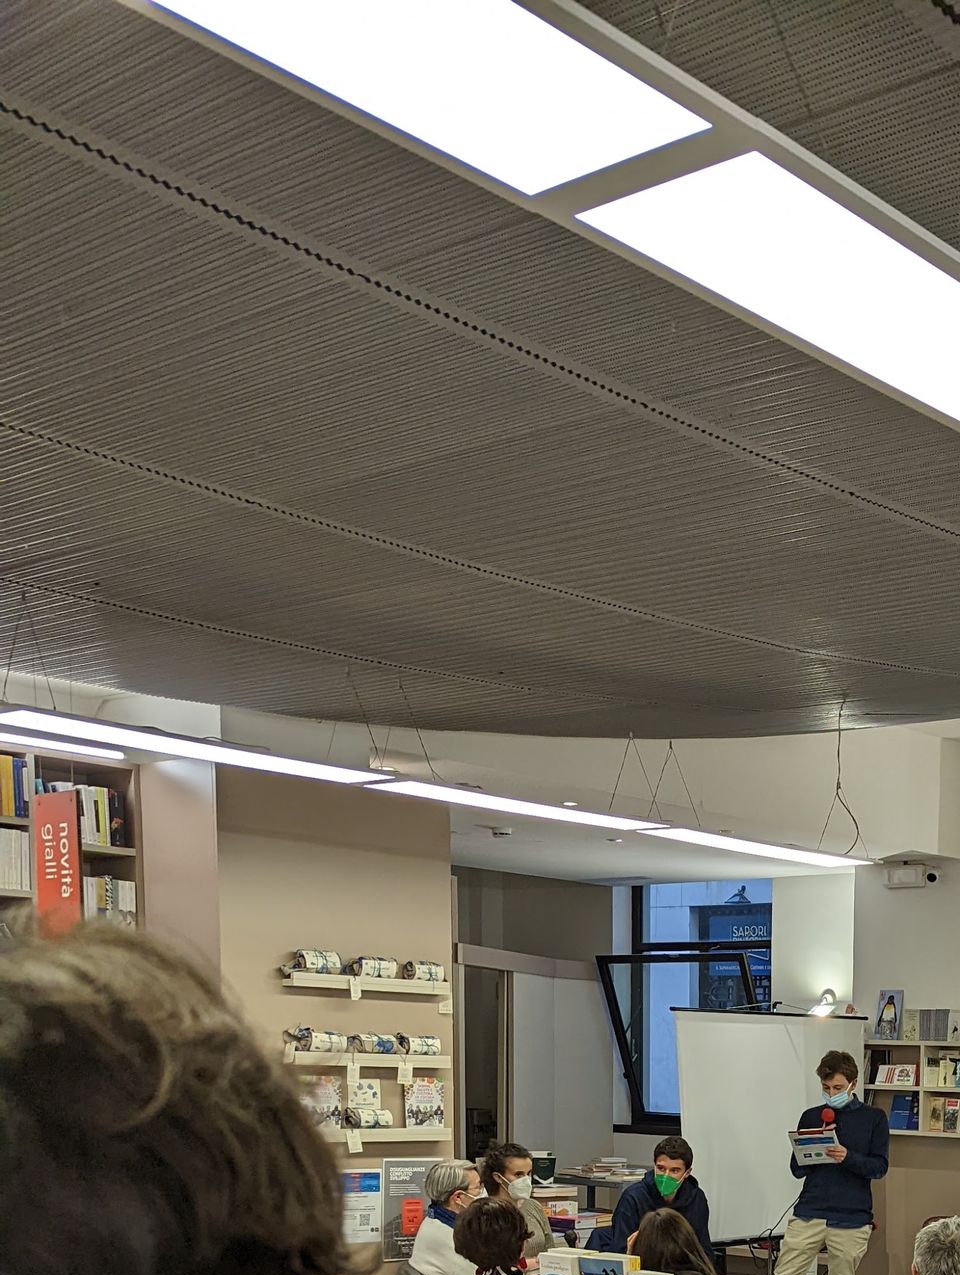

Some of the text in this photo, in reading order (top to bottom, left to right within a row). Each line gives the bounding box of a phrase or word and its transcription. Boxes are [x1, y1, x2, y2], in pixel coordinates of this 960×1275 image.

[41, 823, 57, 879] gialli
[59, 822, 73, 898] novità
[733, 925, 767, 937] SAPORI
